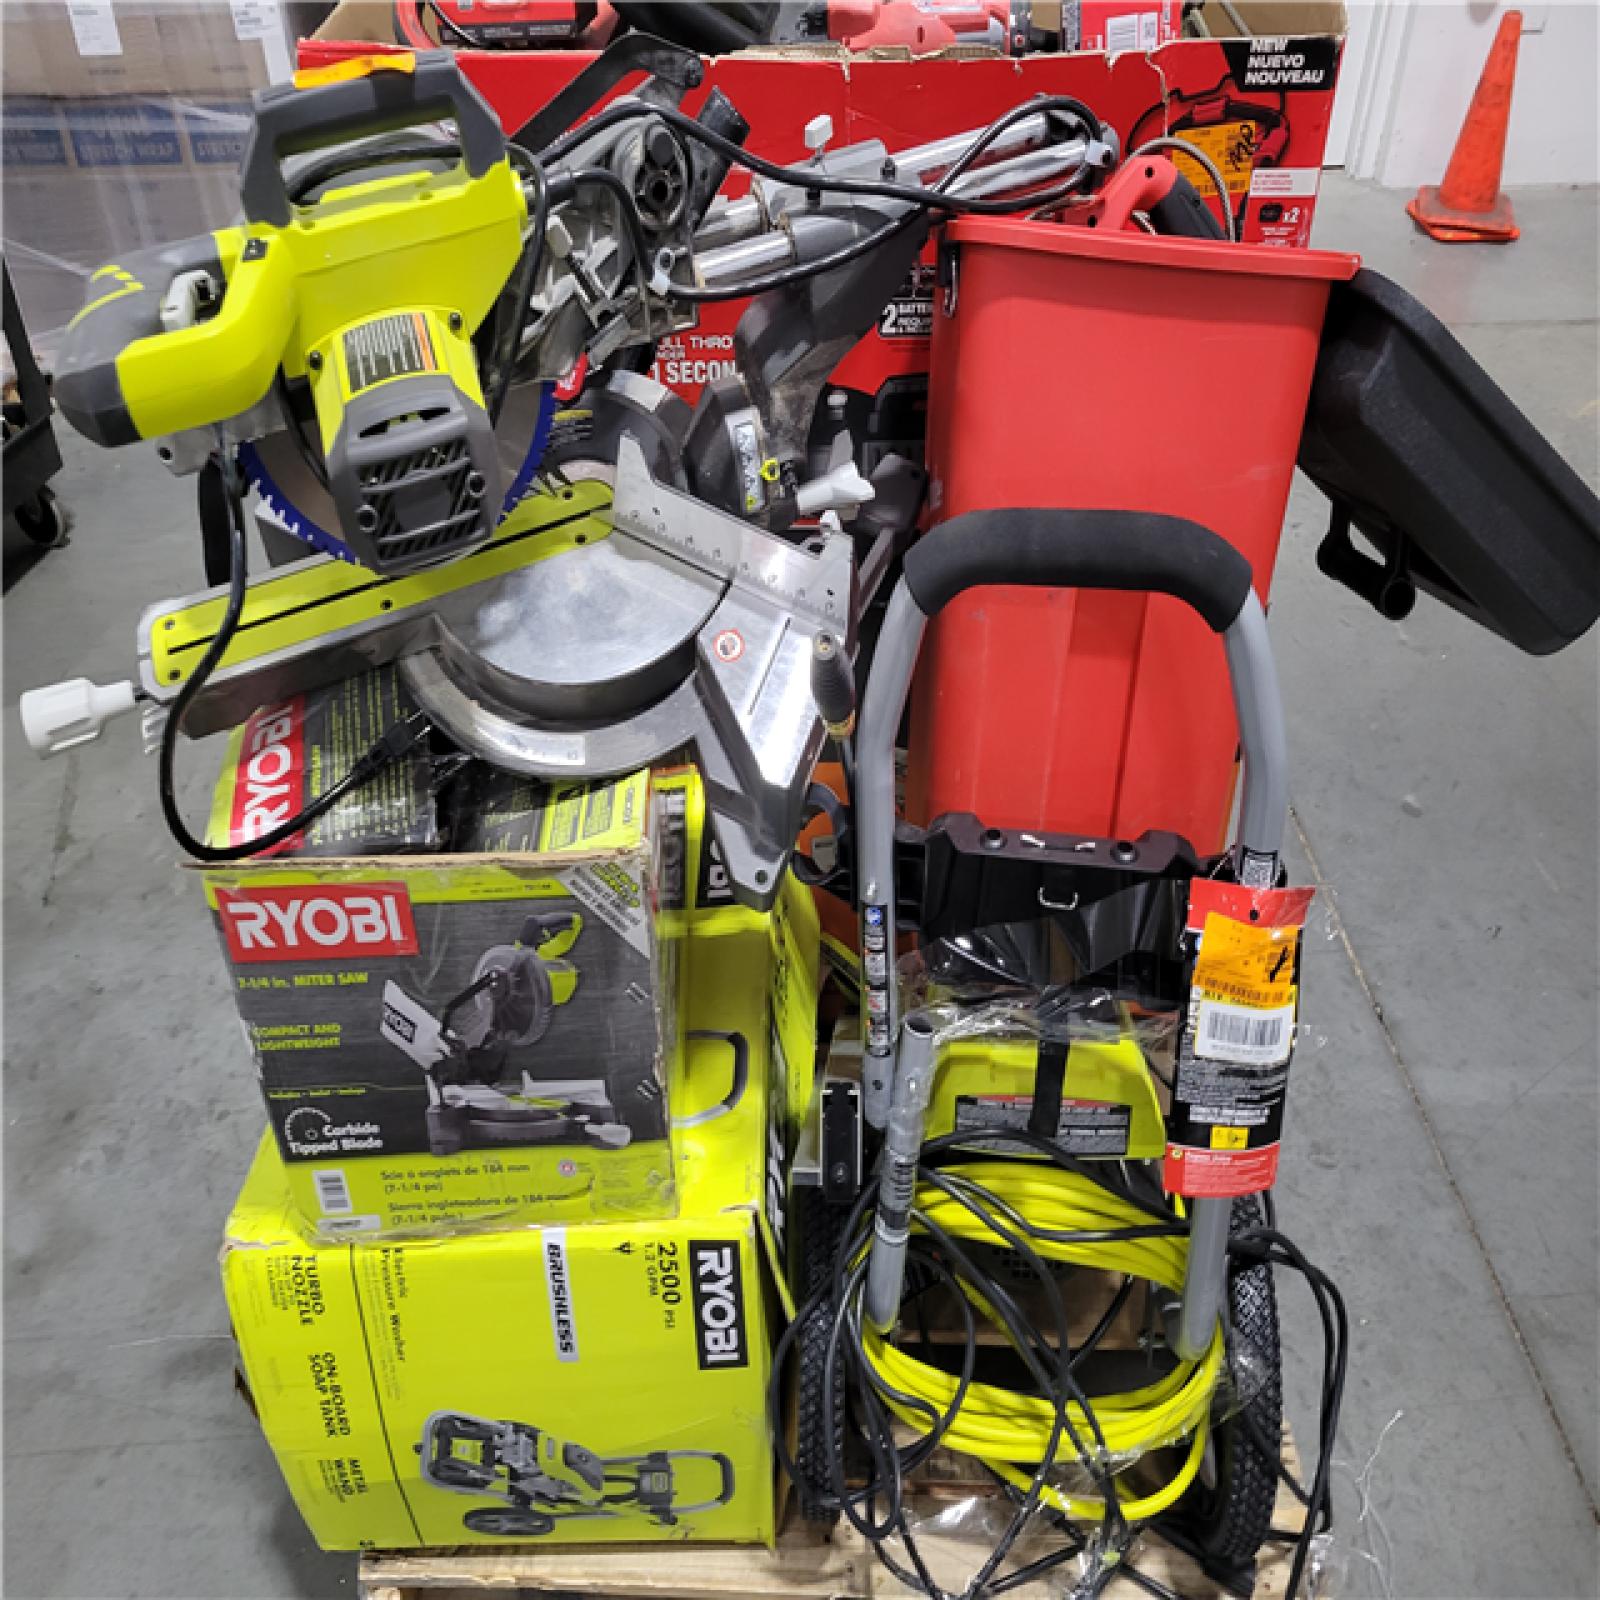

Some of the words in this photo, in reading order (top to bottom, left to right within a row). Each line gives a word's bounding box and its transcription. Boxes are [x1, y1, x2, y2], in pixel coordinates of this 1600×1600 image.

[1247, 54, 1305, 68] NUEVO
[1250, 38, 1288, 53] NEW
[1244, 69, 1325, 84] NOUVEAU
[881, 304, 897, 334] 2
[689, 335, 733, 350] THRO
[666, 359, 738, 384] SECON
[241, 703, 294, 844] RYOBI
[227, 894, 407, 949] RYOBI
[293, 973, 335, 987] MITER
[338, 971, 369, 984] SAW
[290, 1137, 339, 1156] Tipped
[341, 1136, 384, 1151] Blade
[323, 1121, 381, 1138] Carbide
[291, 1254, 314, 1325] NOZZLE
[304, 1255, 325, 1316] TURBO
[657, 1241, 682, 1306] 2500
[546, 1242, 575, 1354] BRUSHLESS
[698, 1248, 740, 1365] RYOBI
[308, 1353, 328, 1395] SOAP
[319, 1398, 338, 1438] TANK
[322, 1351, 351, 1436] ON-BOARD
